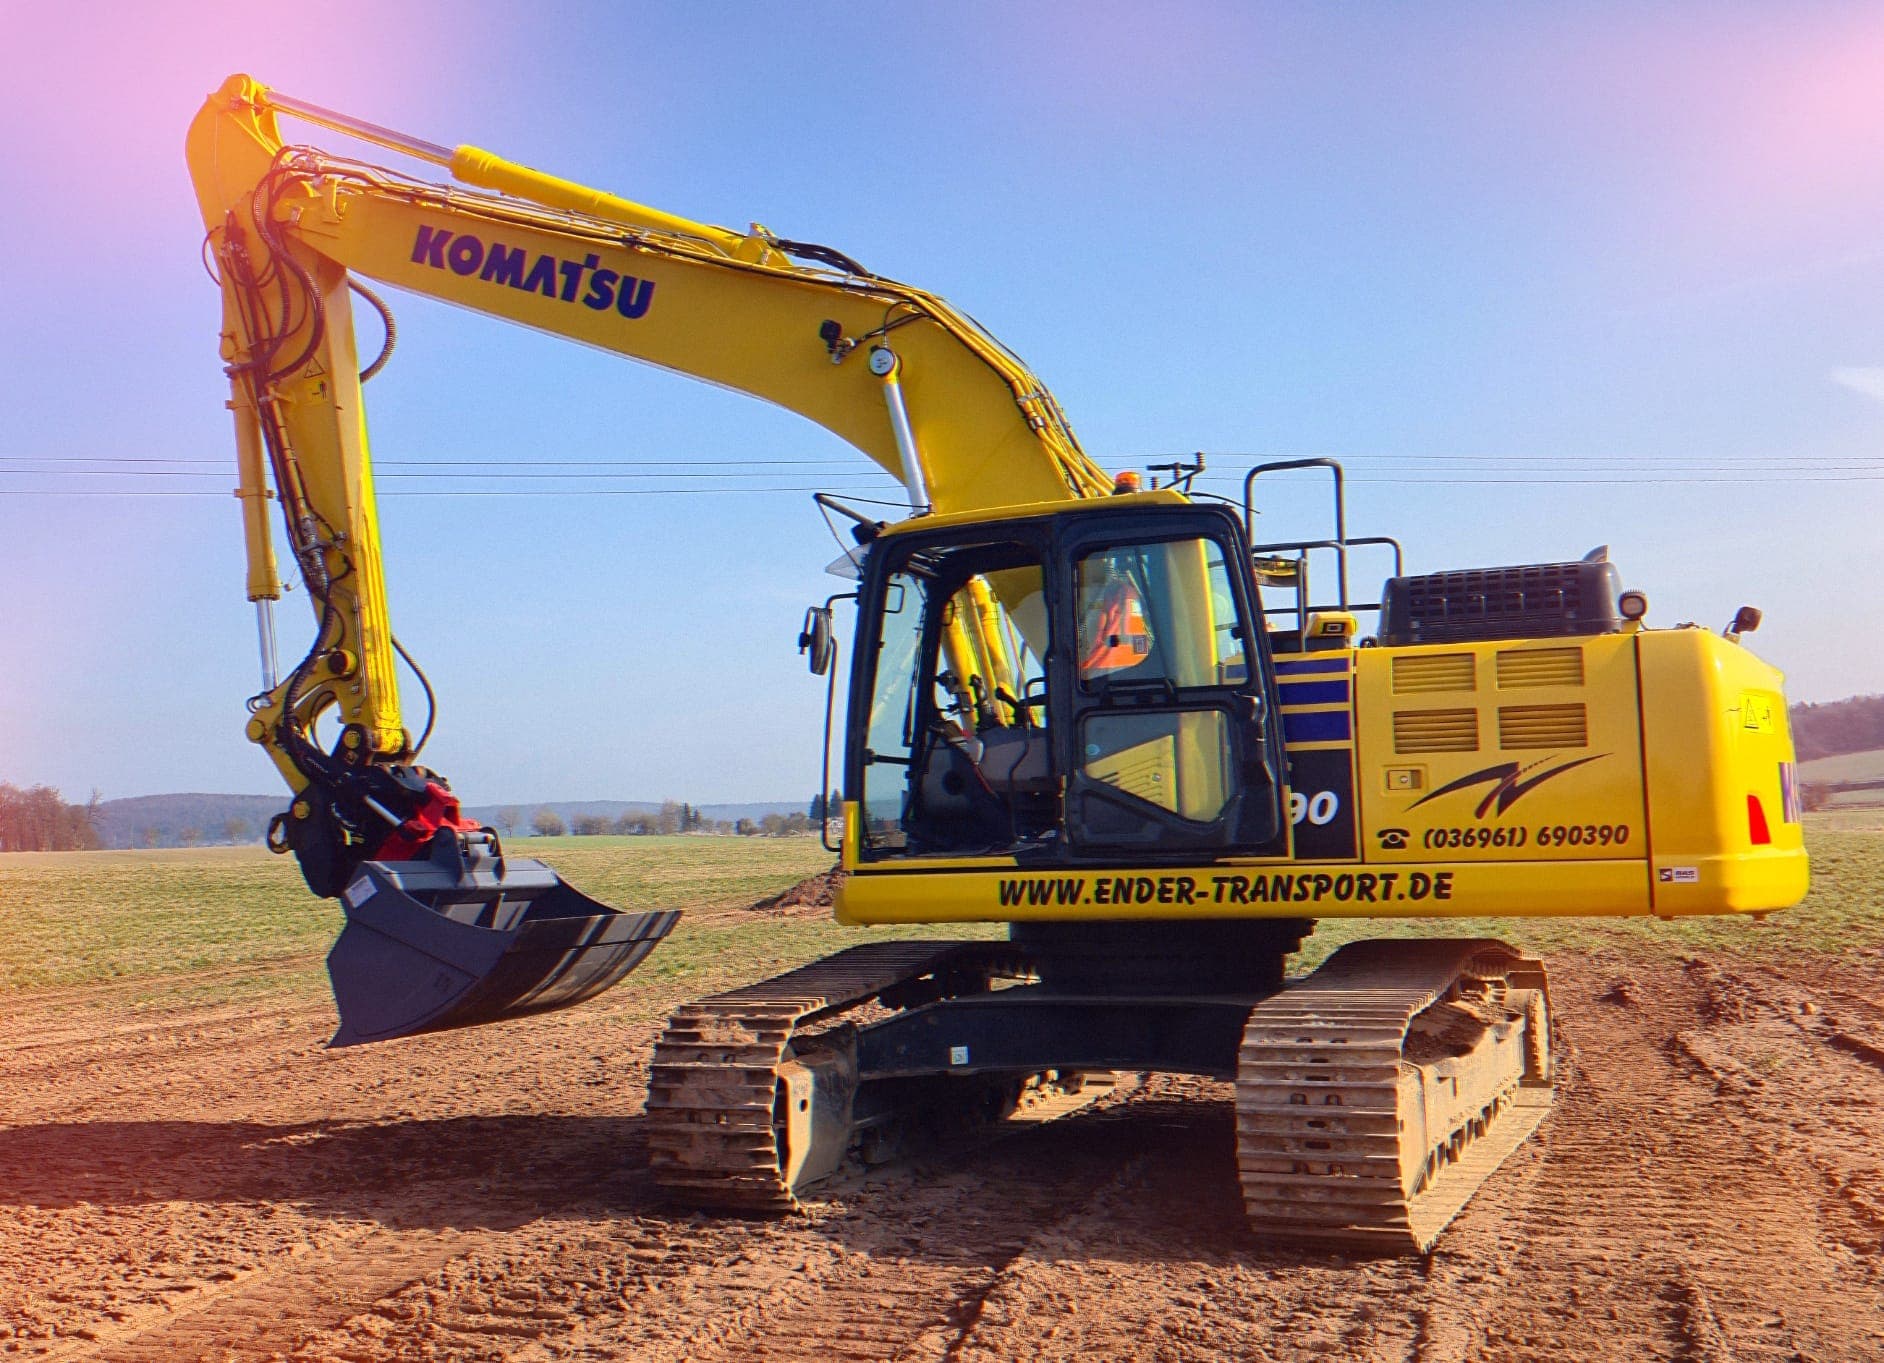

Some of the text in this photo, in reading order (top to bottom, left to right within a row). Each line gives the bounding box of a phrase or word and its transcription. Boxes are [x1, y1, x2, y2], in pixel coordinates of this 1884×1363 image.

[411, 224, 656, 319] KOMATSU
[1290, 790, 1339, 826] 90
[1424, 824, 1630, 850] (036961) 690390
[998, 872, 1454, 907] WWW.ENDER-TRANSPORT.DE
